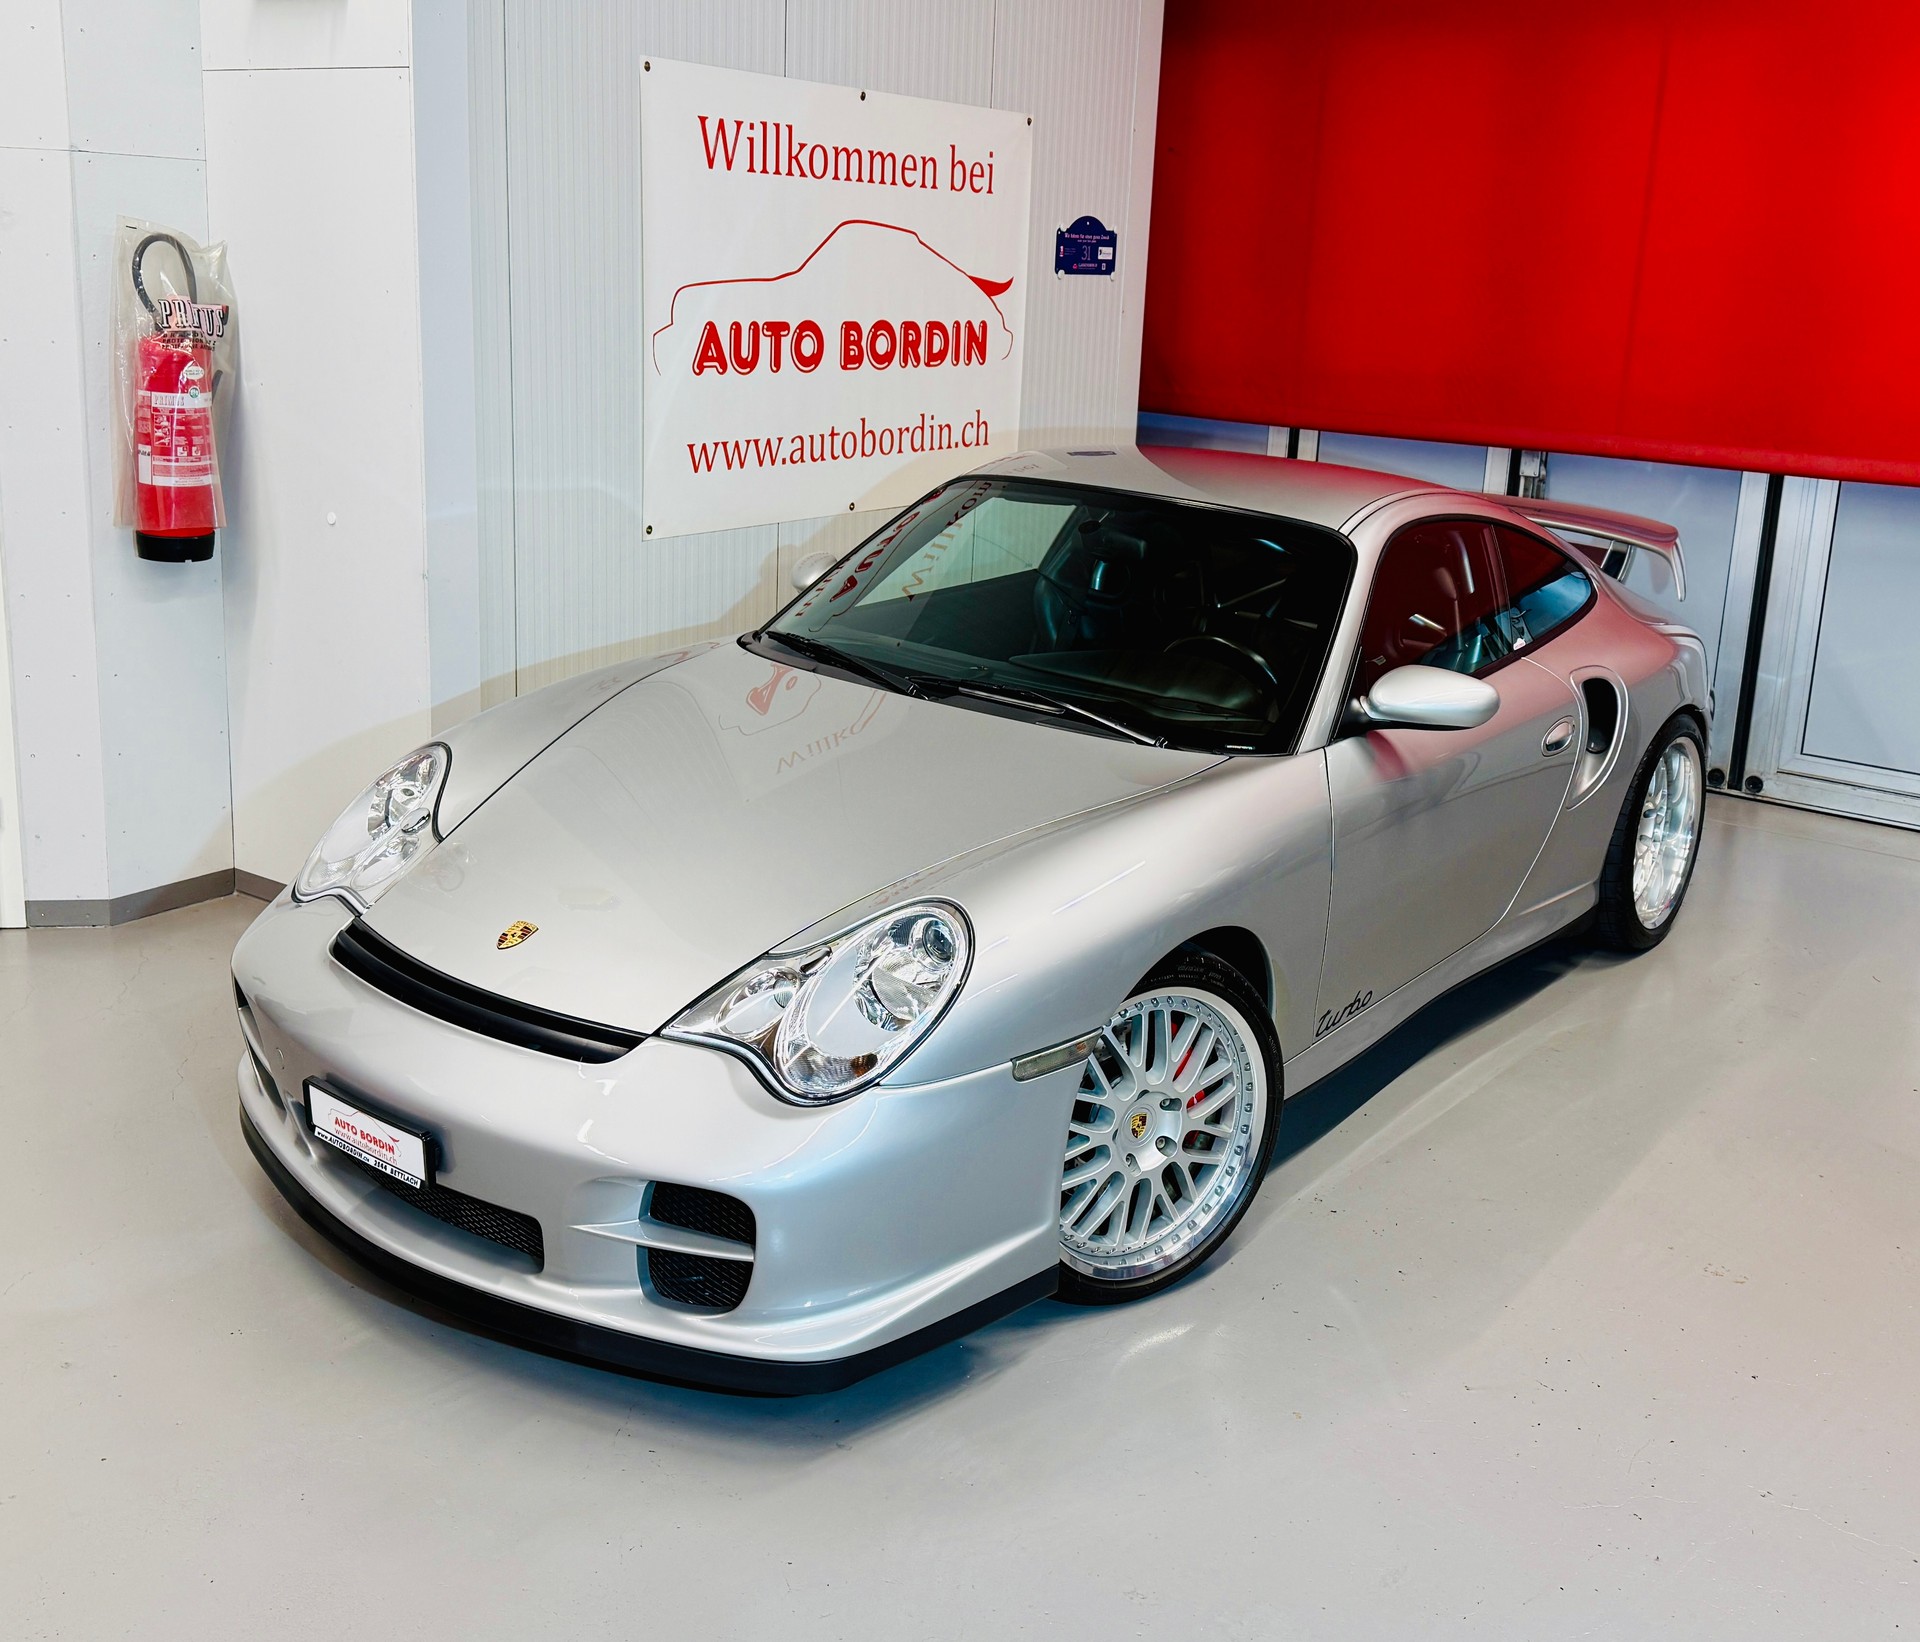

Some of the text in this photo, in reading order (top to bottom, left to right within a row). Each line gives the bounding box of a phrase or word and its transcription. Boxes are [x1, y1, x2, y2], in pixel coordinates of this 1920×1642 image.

[697, 114, 995, 196] Willkommen bei
[691, 318, 990, 378] AUTO BORDIN
[687, 408, 990, 474] www.autobordin.ch
[335, 1117, 395, 1155] AUTO BORDIN
